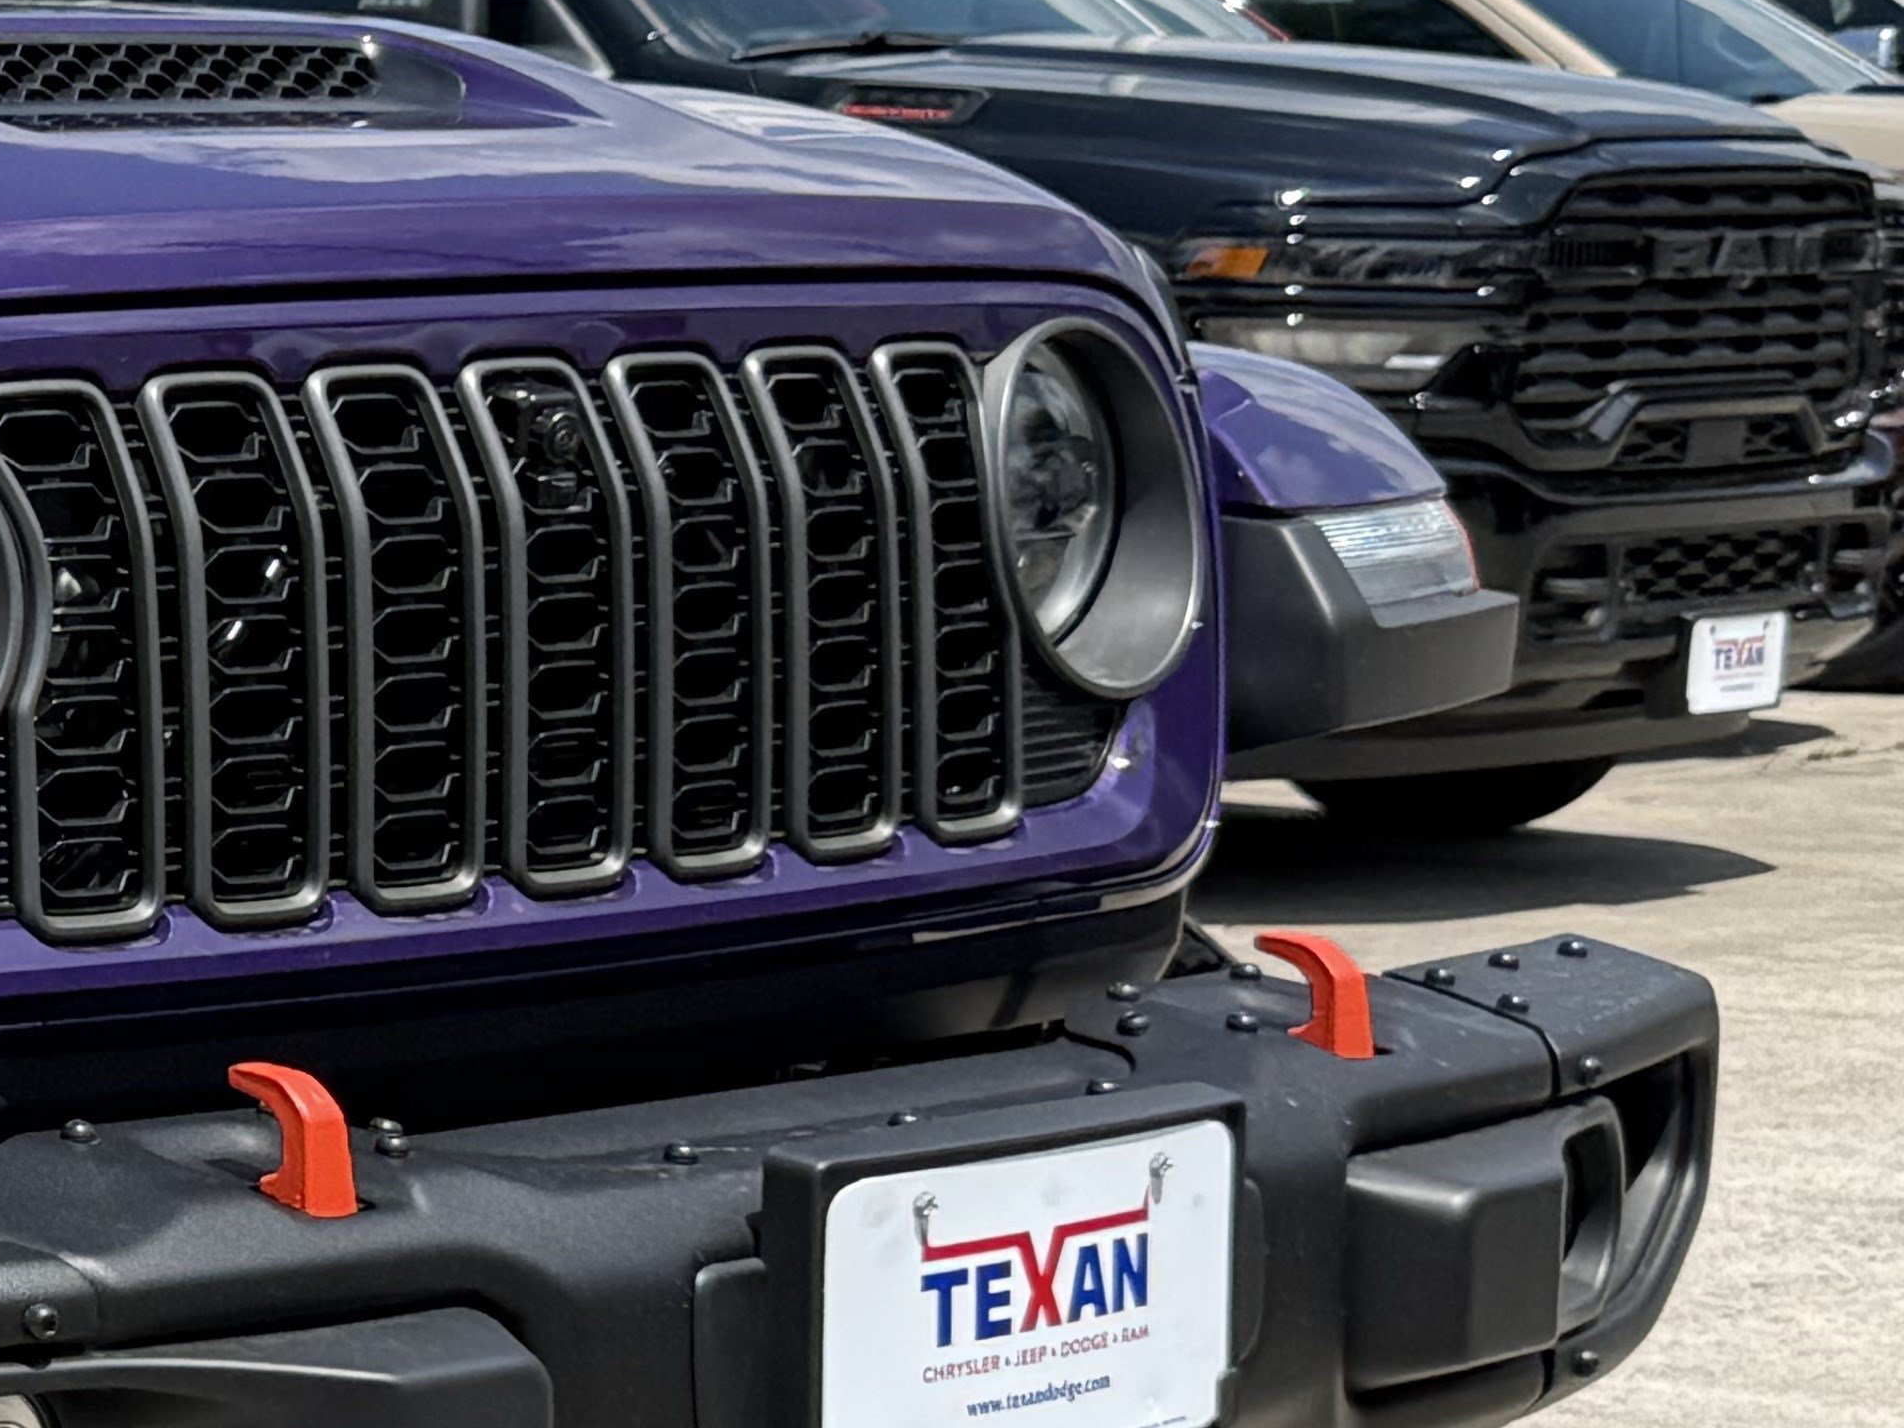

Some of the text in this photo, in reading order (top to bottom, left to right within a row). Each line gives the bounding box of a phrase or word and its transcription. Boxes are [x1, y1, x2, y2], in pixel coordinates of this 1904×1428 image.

[1712, 639, 1766, 672] TEXAN
[918, 1222, 1150, 1349] TEXAN
[922, 1324, 1150, 1384] CHRYSLER JEEP DODGE RAM
